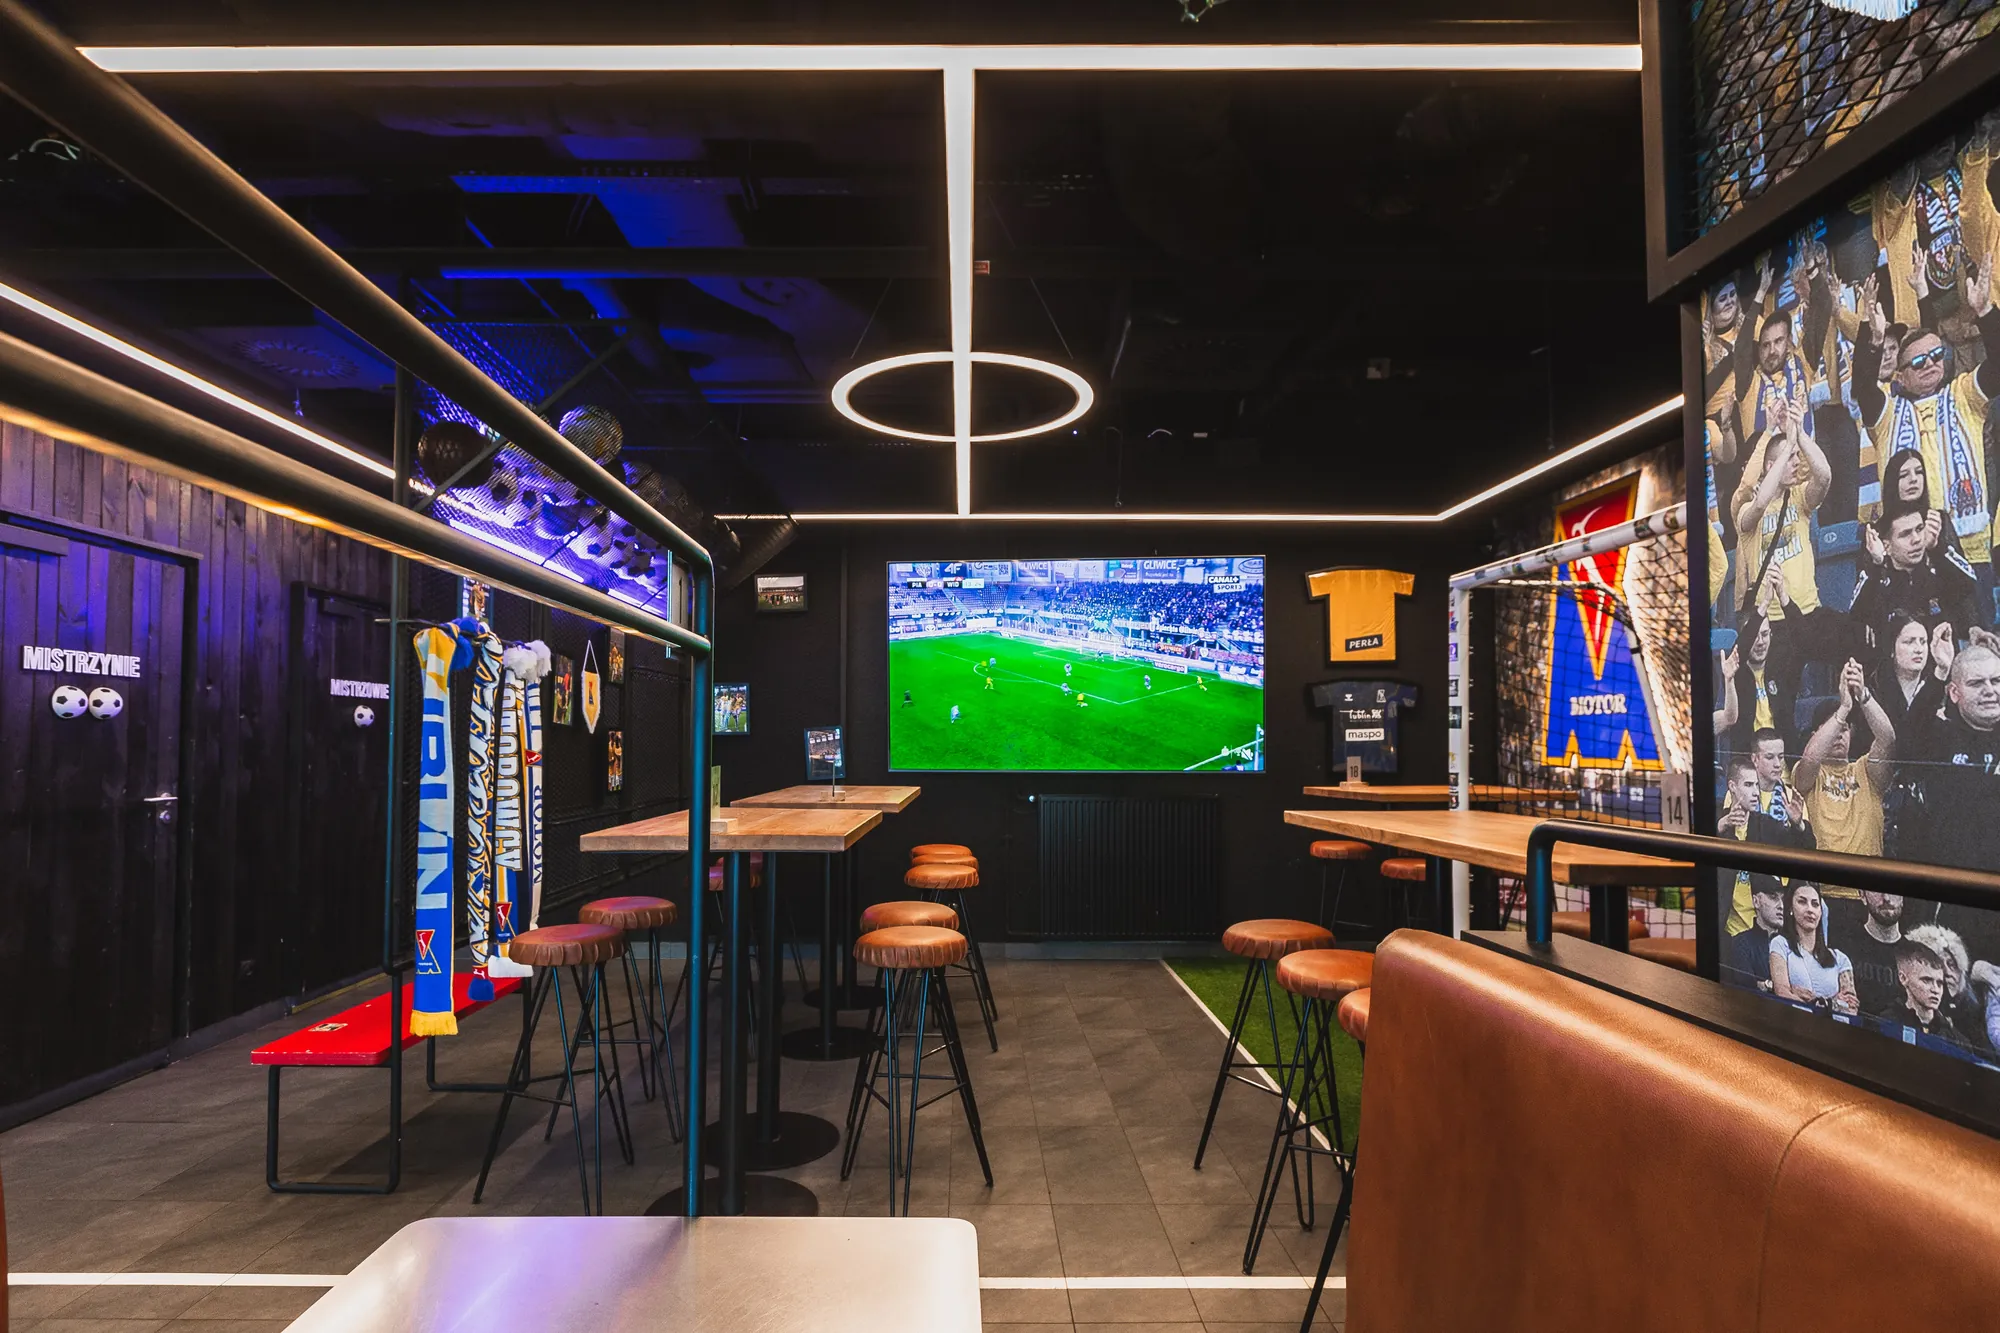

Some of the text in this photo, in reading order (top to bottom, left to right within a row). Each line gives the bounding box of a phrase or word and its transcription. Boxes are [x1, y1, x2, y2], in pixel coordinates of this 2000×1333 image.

[1143, 560, 1177, 570] GLIWICE
[1349, 637, 1379, 650] PERŁA
[23, 645, 141, 678] MISTRZYNIE
[330, 678, 390, 700] MISTRZOWIE
[1569, 693, 1628, 717] MOTOR
[1347, 730, 1382, 740] maspo
[1349, 765, 1359, 778] 18
[1666, 796, 1683, 826] 14
